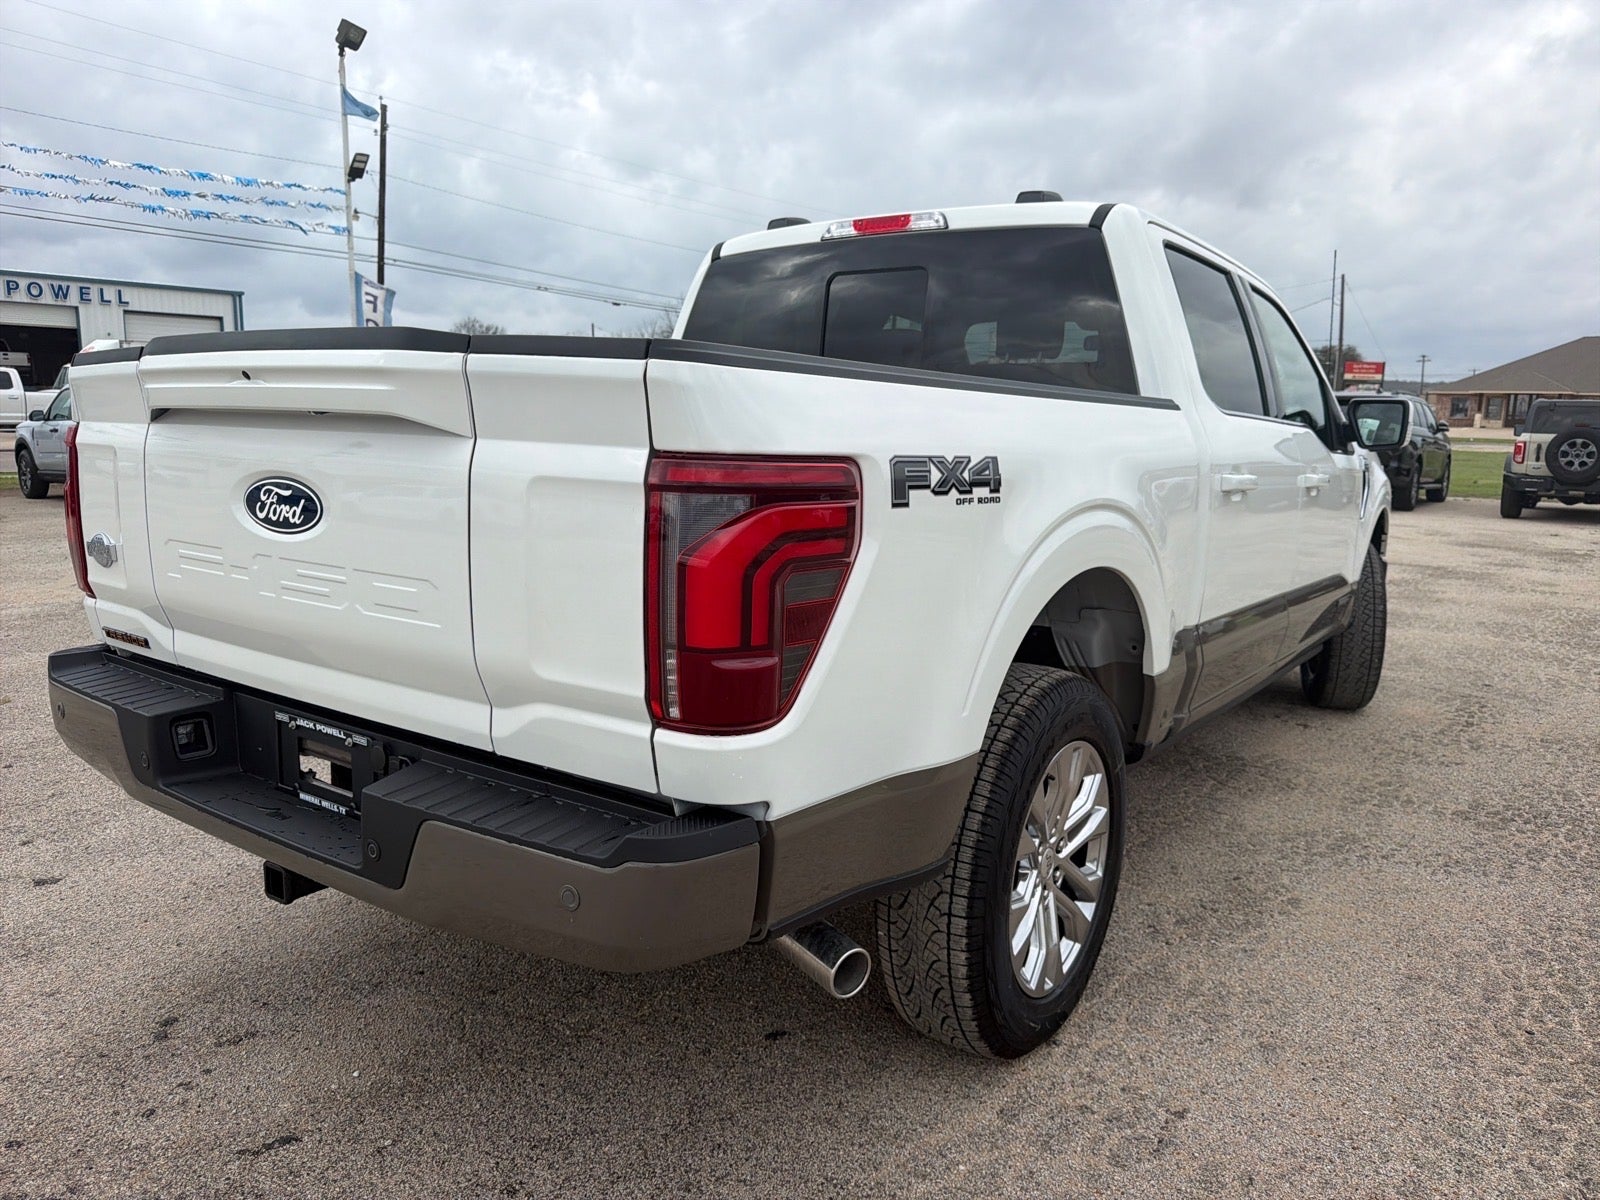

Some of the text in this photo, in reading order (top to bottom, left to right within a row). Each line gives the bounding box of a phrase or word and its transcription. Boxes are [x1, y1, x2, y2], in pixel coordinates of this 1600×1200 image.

[4, 279, 130, 305] POWELL
[889, 455, 1002, 509] FX4
[255, 484, 306, 525] Ford
[955, 496, 1001, 506] OFF ROAD
[295, 717, 315, 731] JACK
[315, 723, 347, 739] POWELL
[299, 792, 321, 806] MINERAL
[338, 807, 347, 815] TX
